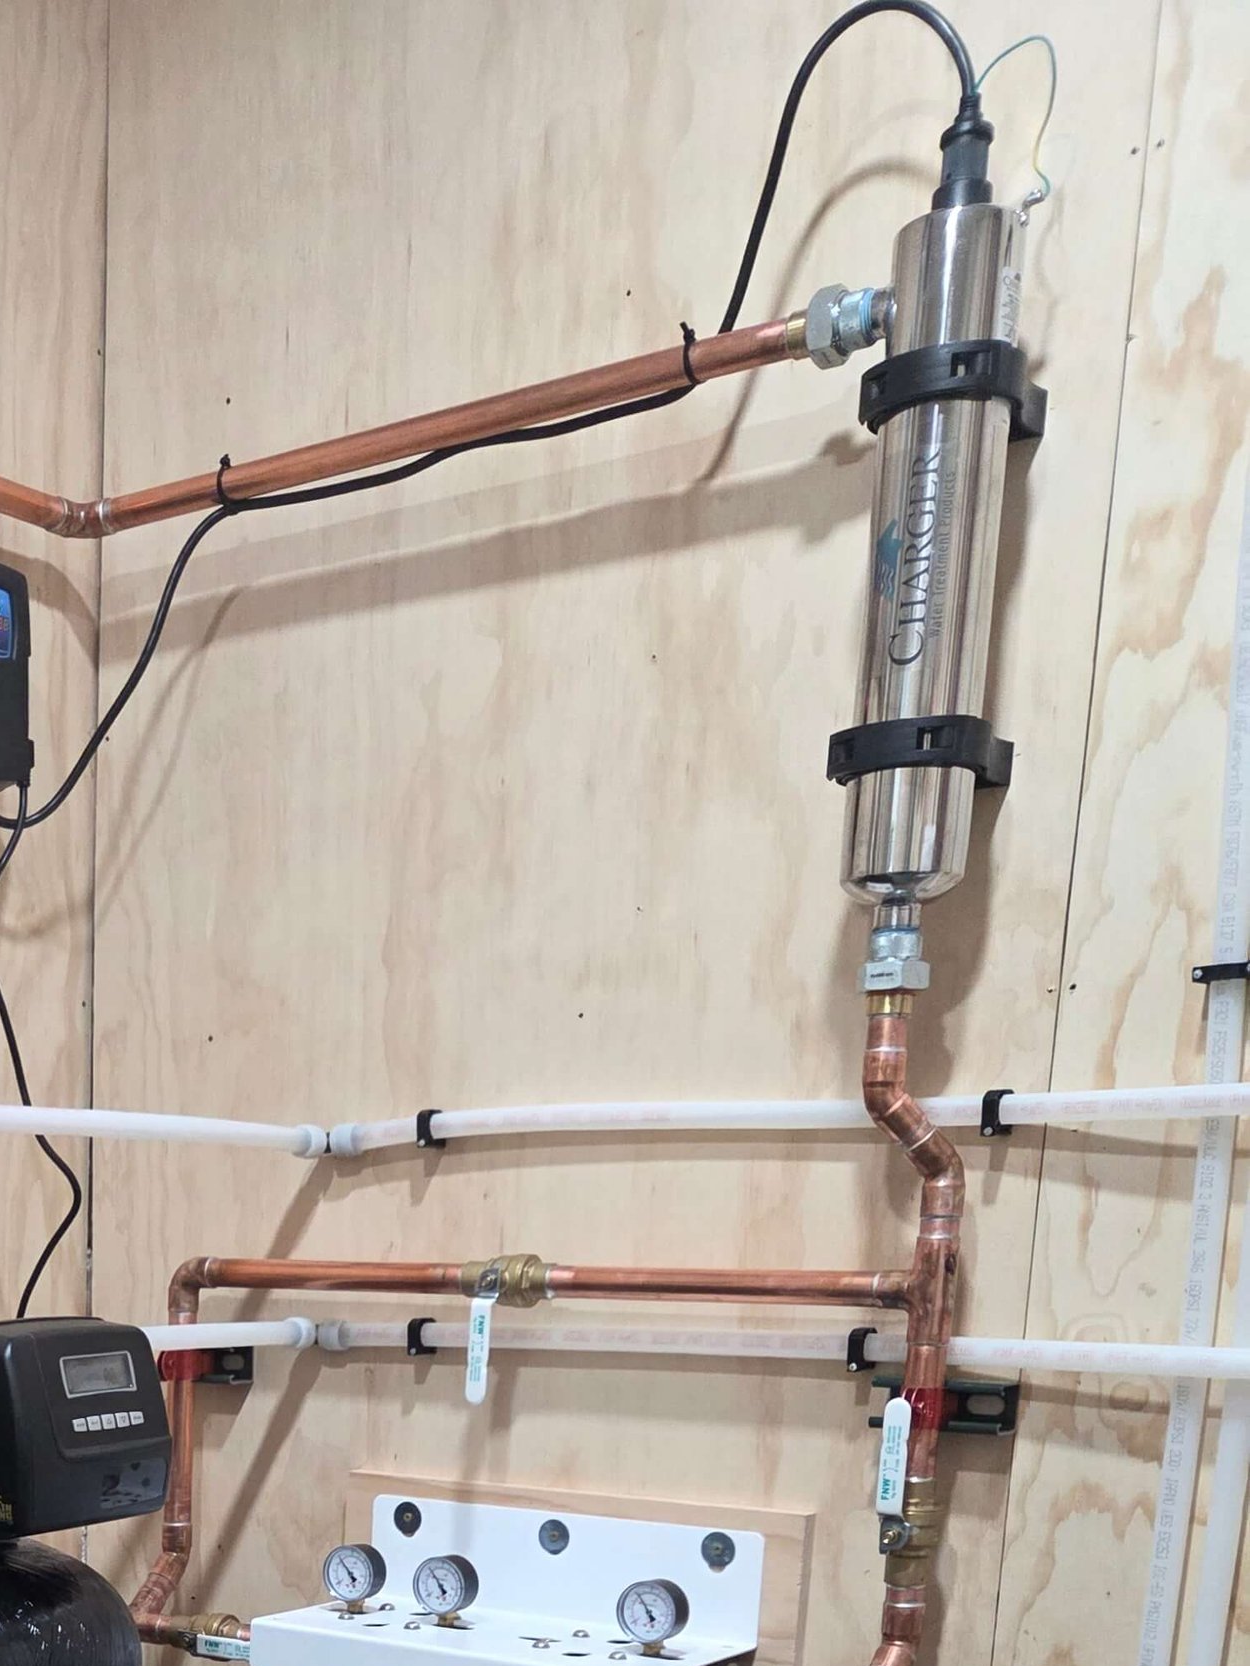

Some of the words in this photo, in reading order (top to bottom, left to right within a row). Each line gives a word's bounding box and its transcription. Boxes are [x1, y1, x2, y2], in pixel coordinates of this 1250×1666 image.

[939, 470, 957, 527] Products
[888, 448, 940, 667] CHARGER
[933, 532, 951, 597] Treatment
[928, 600, 946, 640] Water
[880, 1478, 891, 1501] FNW
